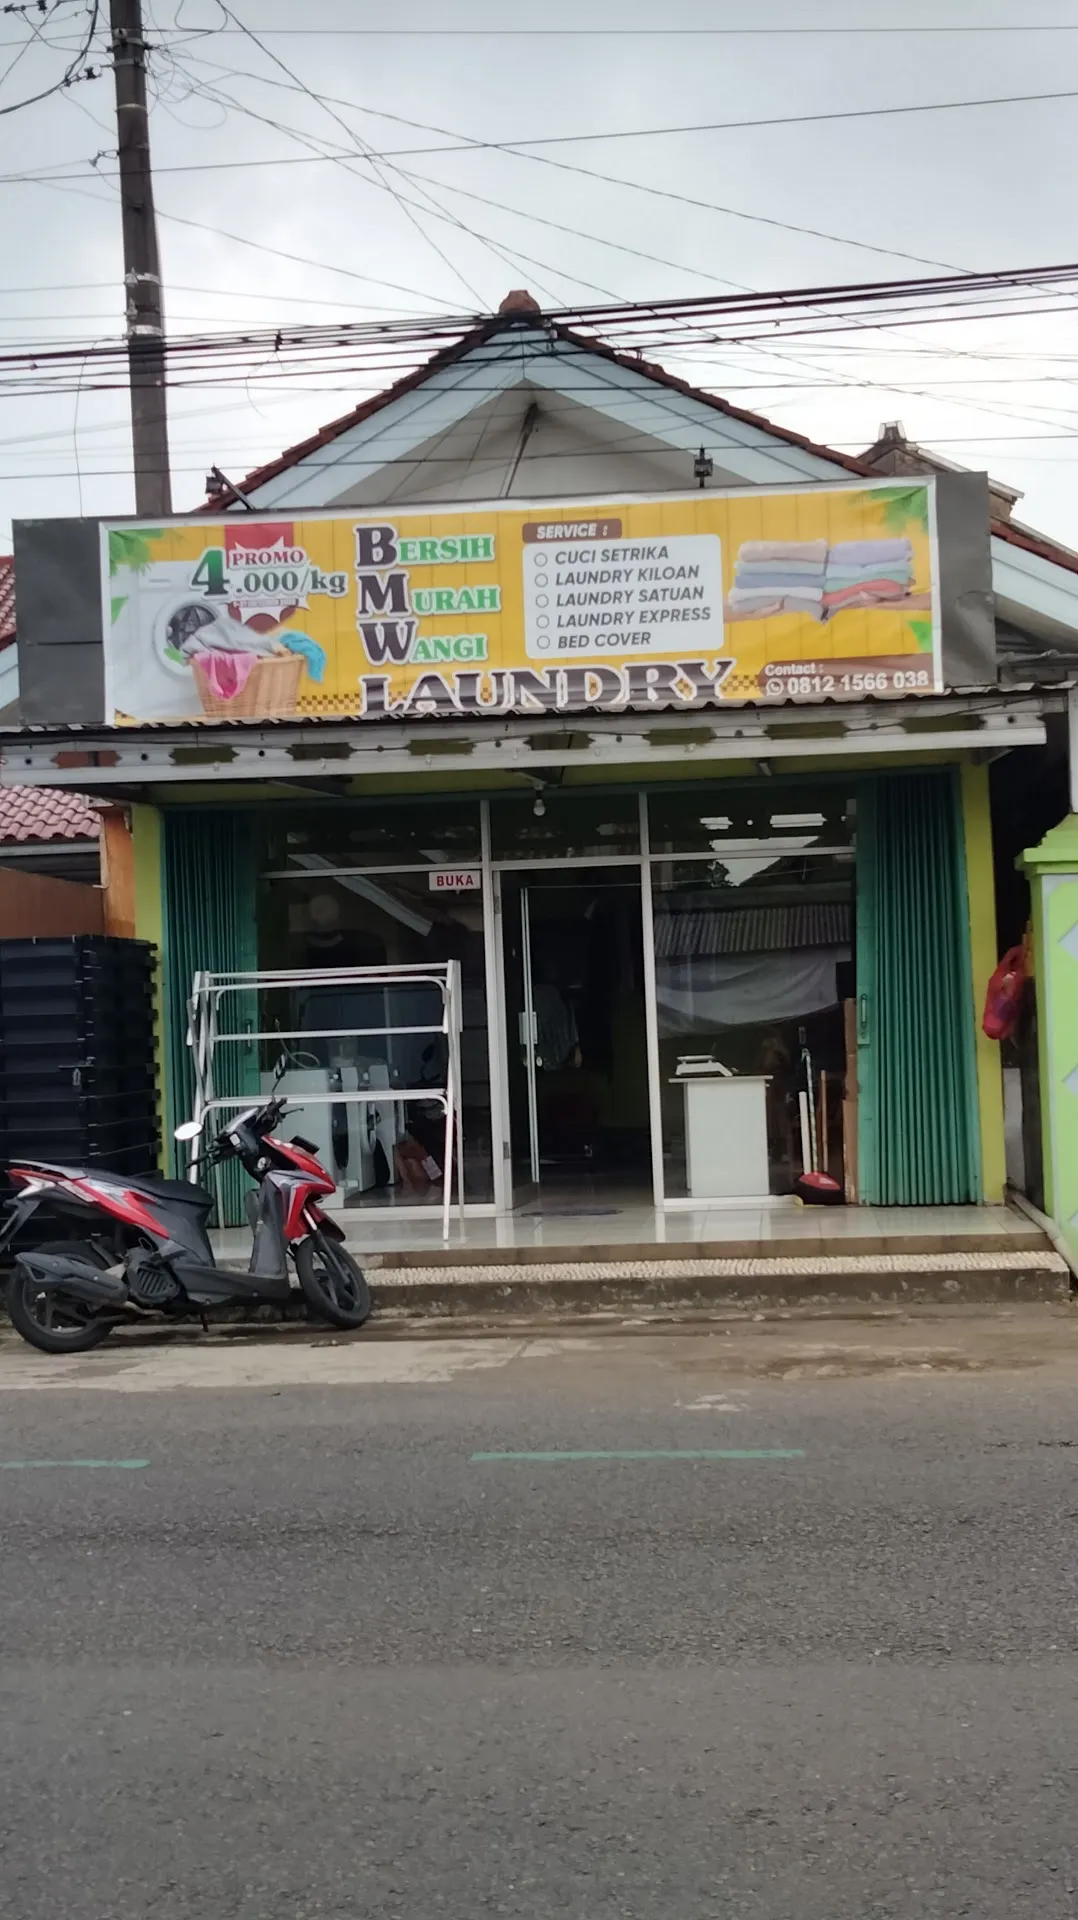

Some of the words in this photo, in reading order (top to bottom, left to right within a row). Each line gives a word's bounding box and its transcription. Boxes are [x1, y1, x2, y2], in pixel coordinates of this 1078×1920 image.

[537, 523, 598, 540] SERVICE
[357, 526, 494, 568] BERSIH
[555, 550, 596, 565] CUCI
[600, 546, 669, 563] SETRIKA
[232, 550, 304, 566] PROMO
[555, 569, 634, 586] LAUNDRY
[637, 565, 700, 582] KILOAN
[358, 574, 500, 617] MURAH
[556, 590, 635, 607] LAUNDRY
[638, 585, 704, 603] SATUAN
[556, 611, 635, 628] LAUNDRY
[639, 607, 711, 624] EXPRESS
[359, 623, 487, 664] WANGI
[557, 635, 590, 649] BED
[594, 631, 652, 647] COVER
[765, 662, 816, 676] Contact
[361, 660, 735, 717] LAUNDRY
[787, 676, 835, 695] 0812
[840, 672, 888, 691] 1566
[893, 670, 929, 688] 038
[436, 874, 474, 887] BUKA
